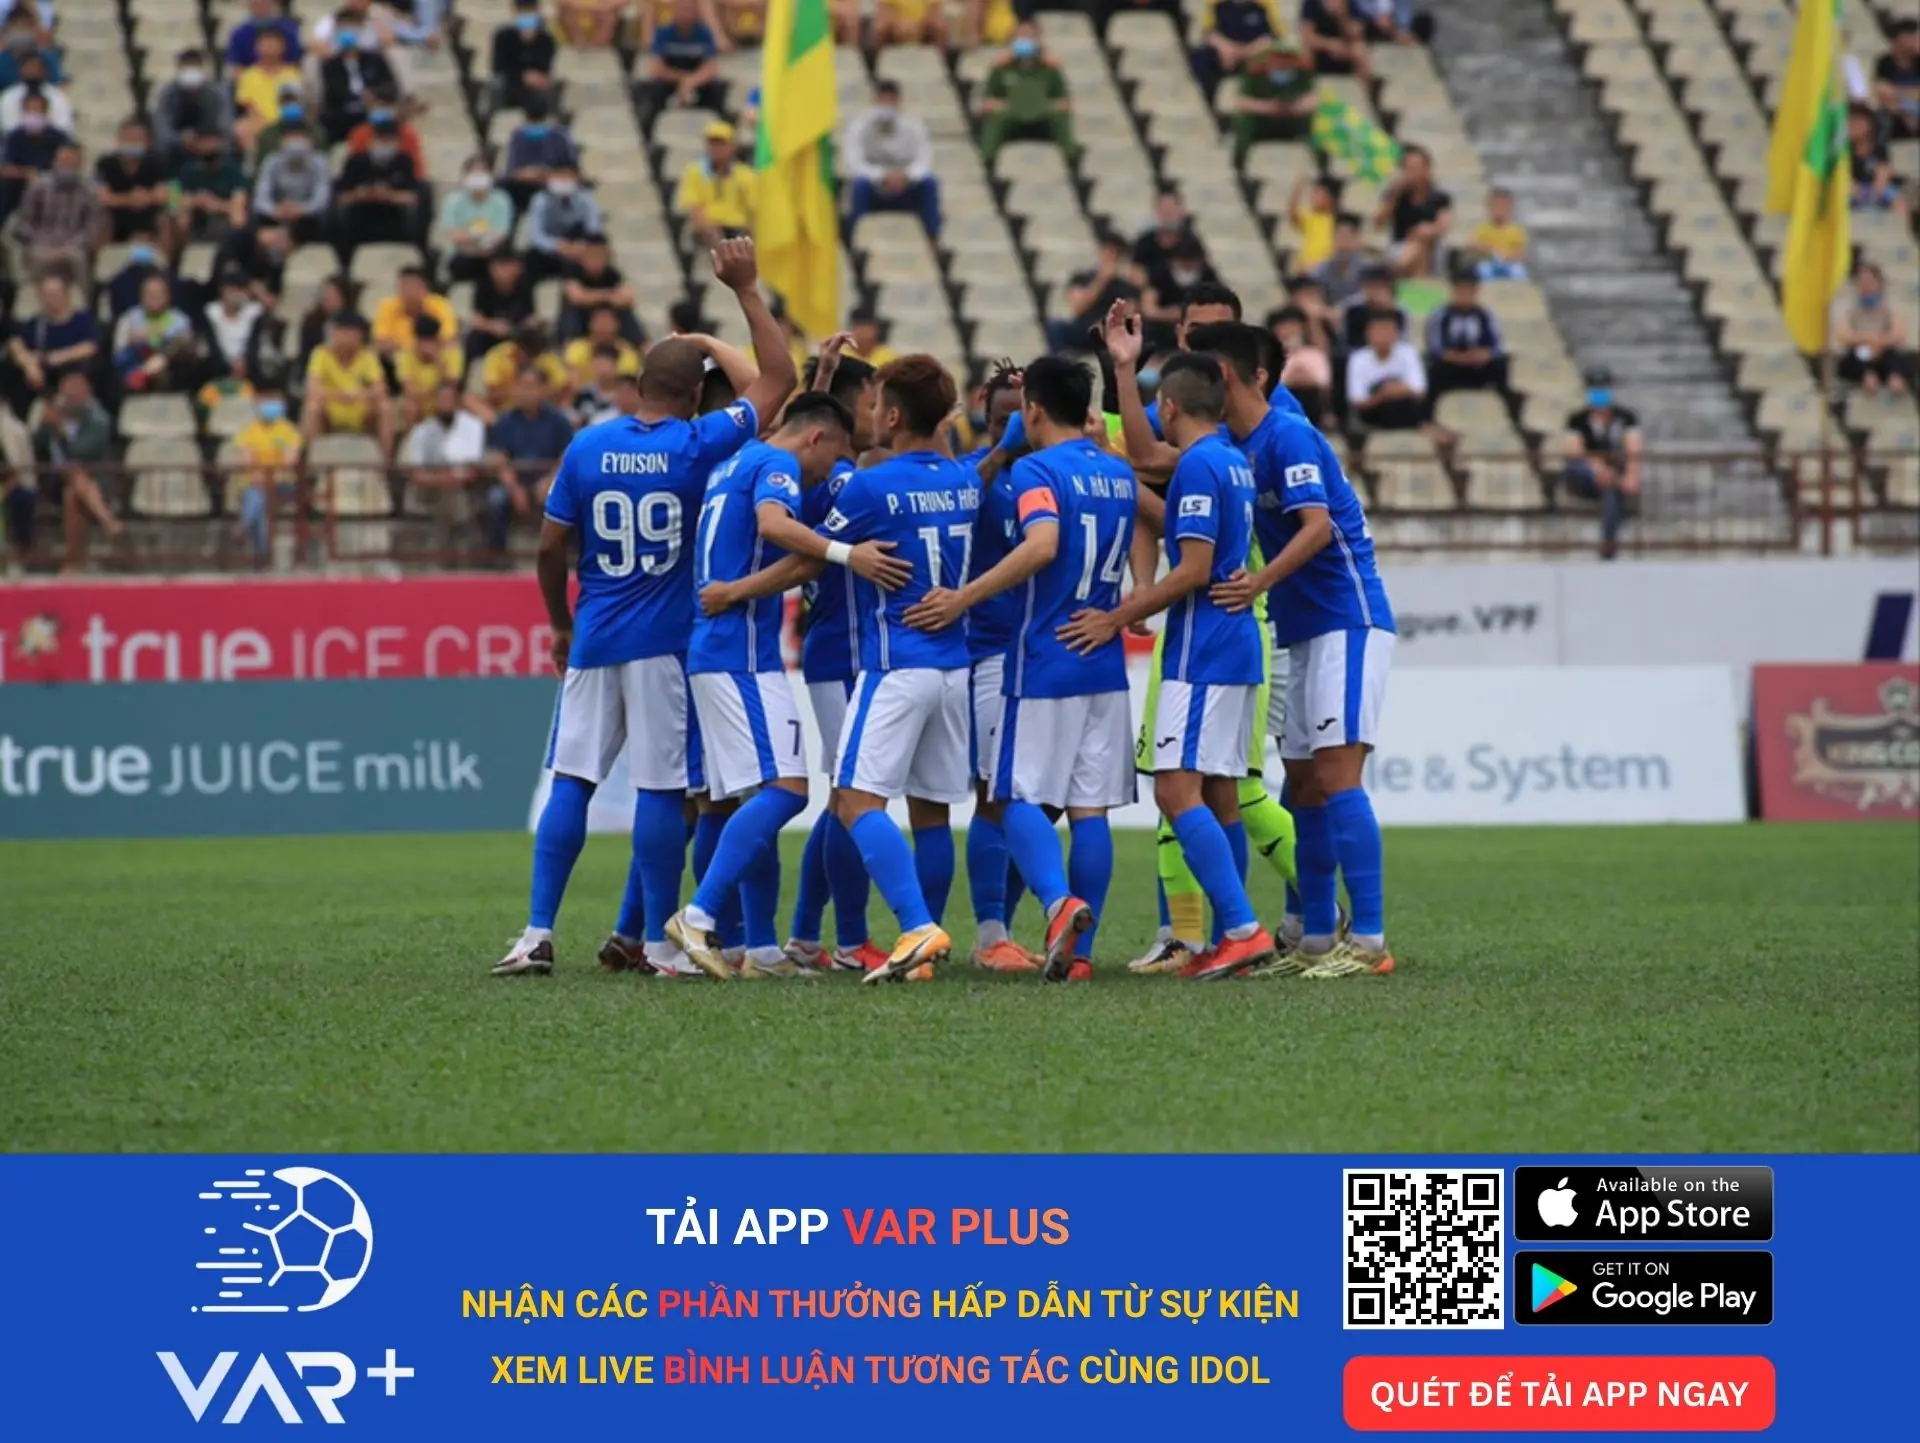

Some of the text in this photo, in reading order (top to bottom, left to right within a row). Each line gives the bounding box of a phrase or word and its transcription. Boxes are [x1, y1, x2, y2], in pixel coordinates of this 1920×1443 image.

[601, 452, 668, 474] EYDISON
[906, 490, 955, 514] TRUNG
[592, 490, 683, 578] 99
[918, 522, 973, 588] 17
[1076, 513, 1128, 600] 14
[82, 614, 272, 683] true
[292, 626, 408, 681] ICE
[1398, 602, 1540, 643] gue.VPF
[0, 734, 482, 796] true JUICE milk
[787, 719, 801, 757] 7
[1424, 754, 1456, 793] &
[1466, 743, 1672, 805] System
